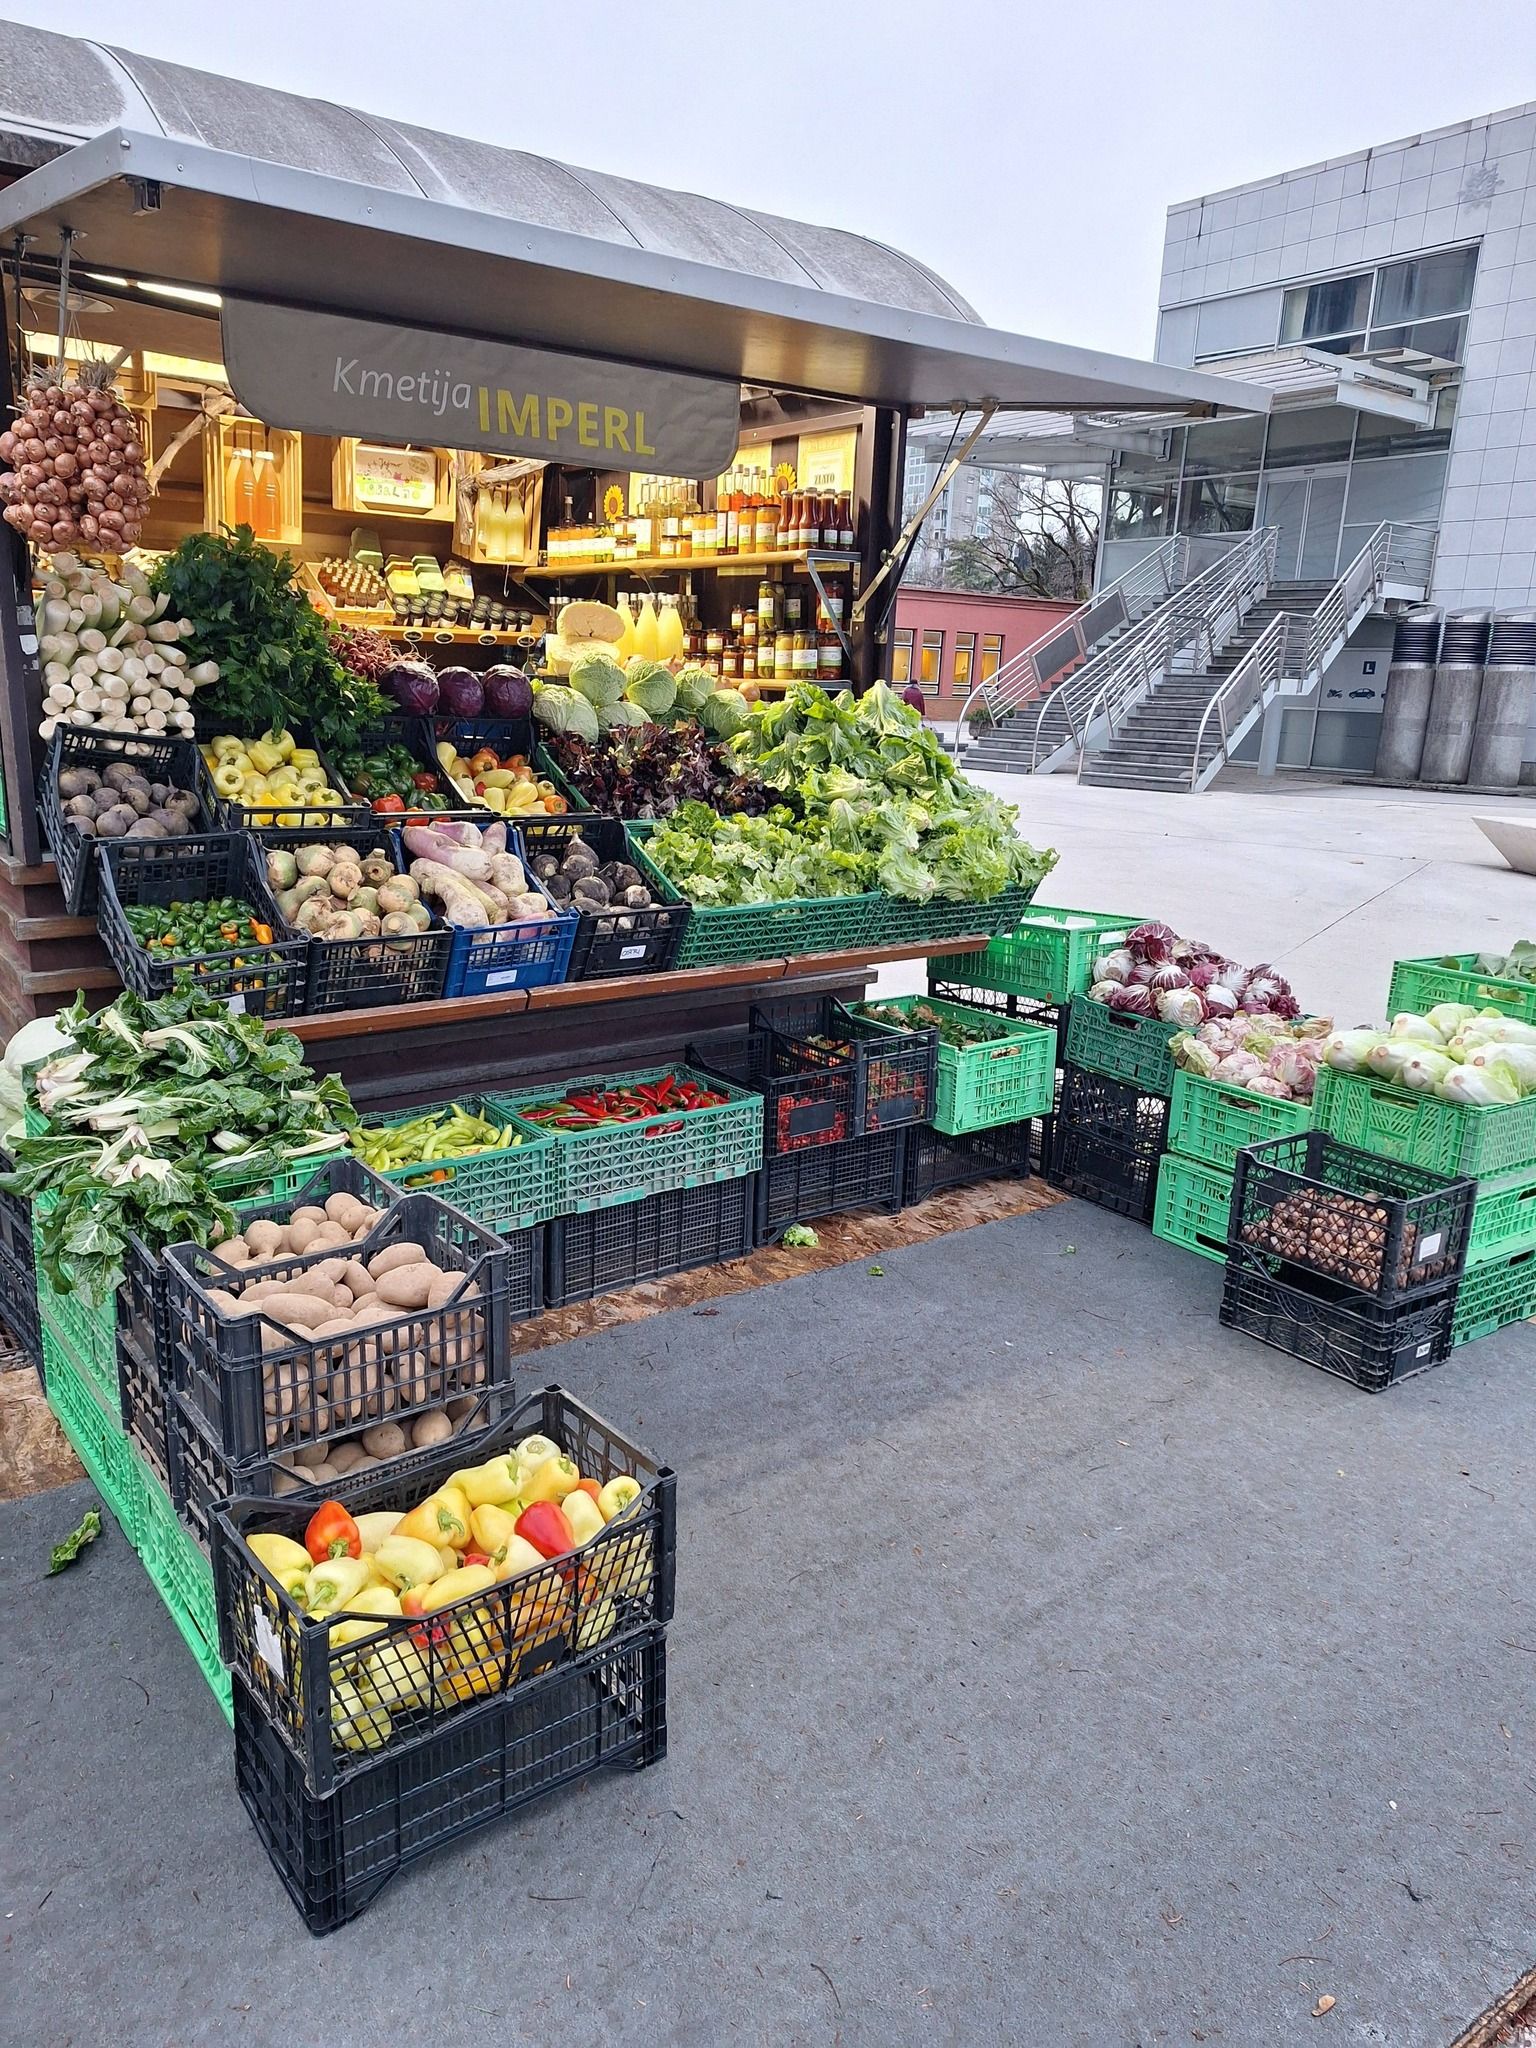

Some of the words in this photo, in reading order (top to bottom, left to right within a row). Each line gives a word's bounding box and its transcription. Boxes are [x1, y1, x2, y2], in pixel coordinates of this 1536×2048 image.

[333, 357, 471, 416] Kmetija
[478, 386, 656, 455] IMPERL
[1364, 662, 1374, 673] L
